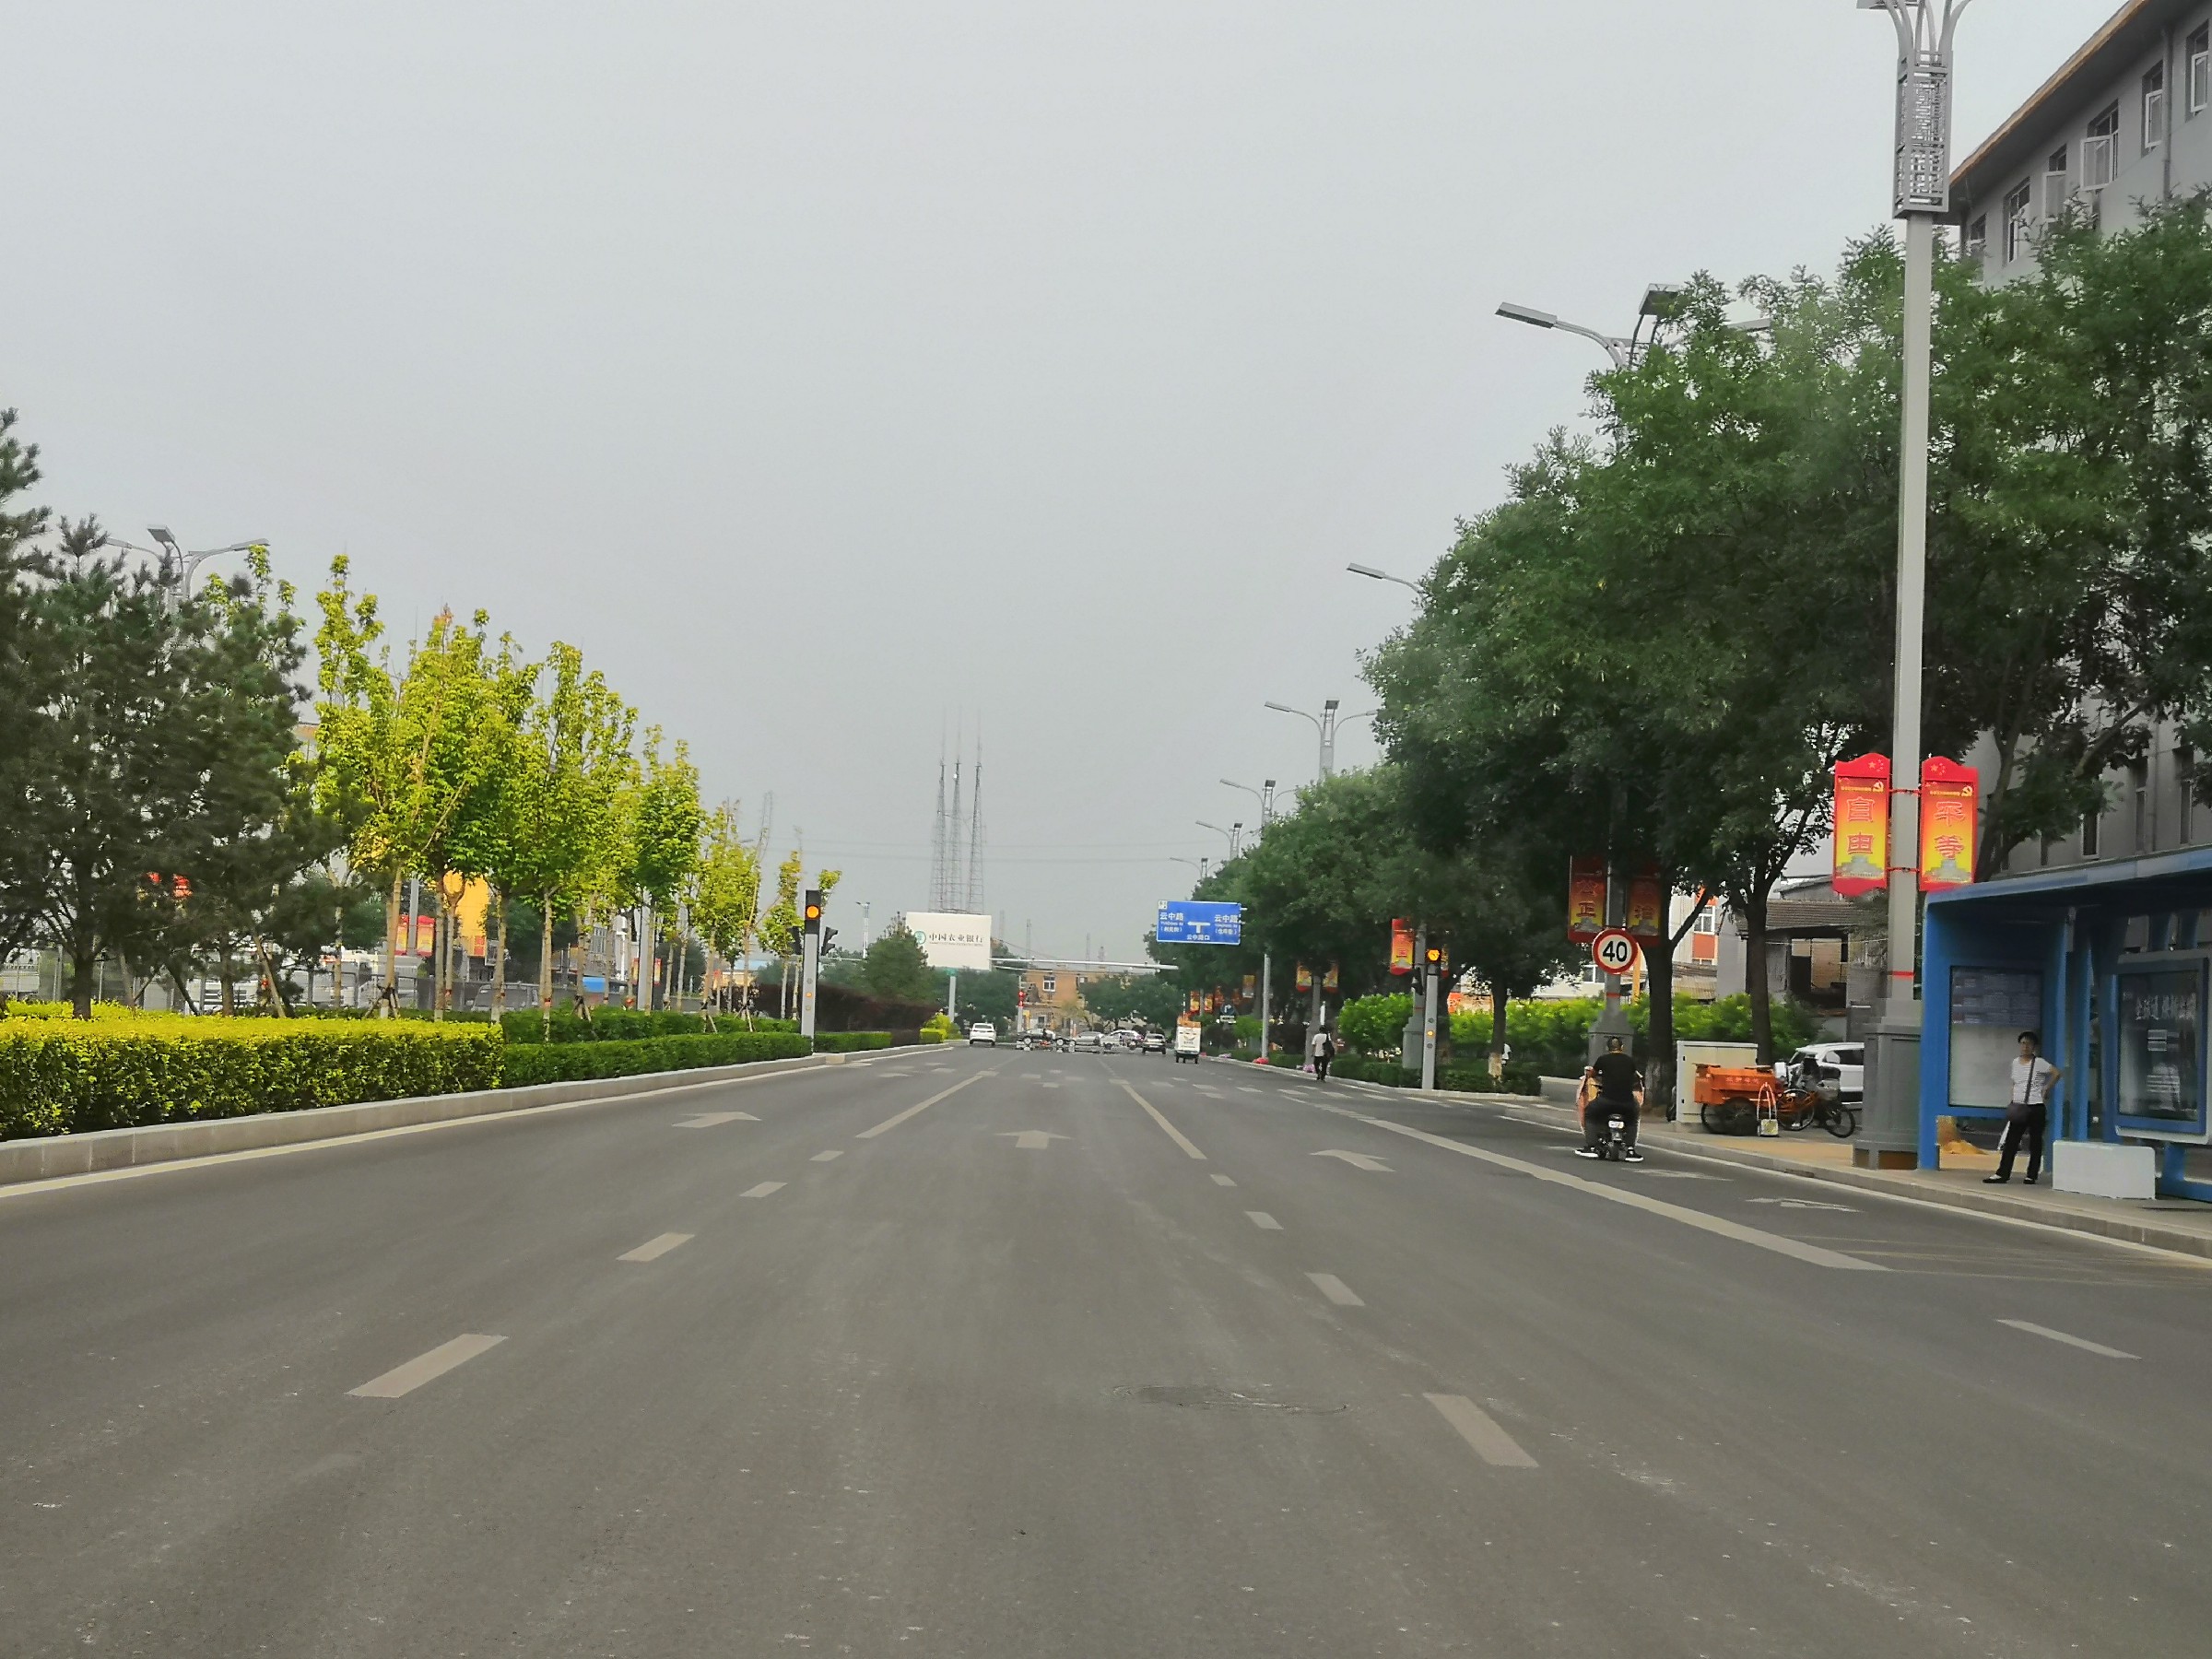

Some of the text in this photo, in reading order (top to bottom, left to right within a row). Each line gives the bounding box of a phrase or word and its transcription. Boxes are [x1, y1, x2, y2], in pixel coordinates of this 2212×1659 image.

[1846, 795, 1876, 855] 自由
[1934, 800, 1967, 861] 平等
[1159, 912, 1184, 922] 云中路
[1214, 913, 1239, 924] 云中路
[928, 932, 983, 943] 中国农业银行
[1602, 940, 1629, 963] 40
